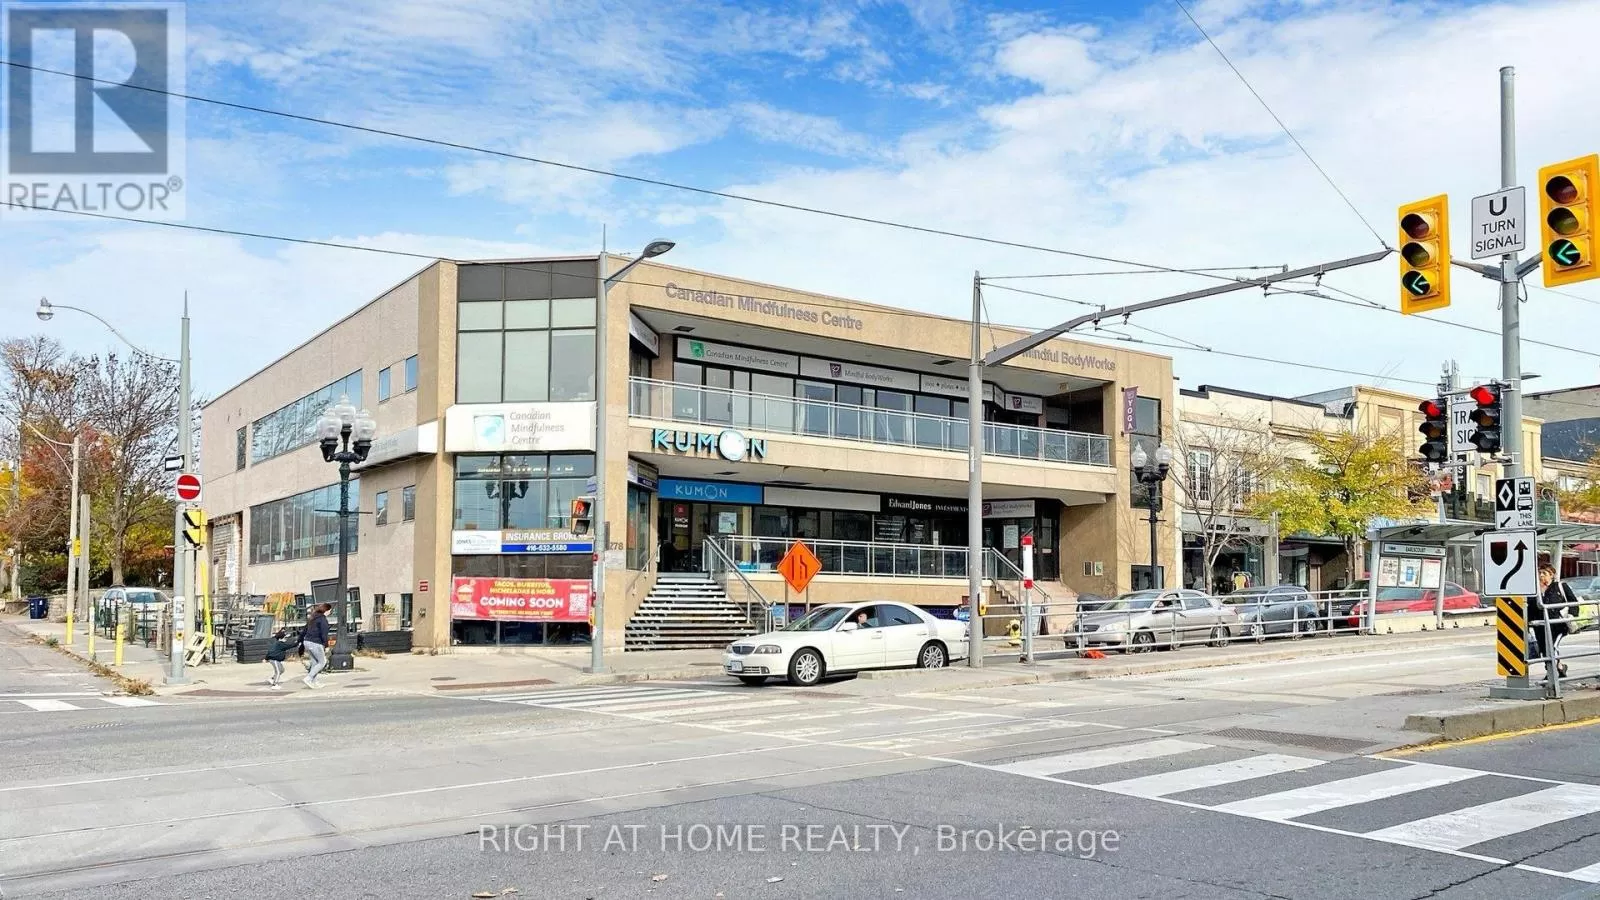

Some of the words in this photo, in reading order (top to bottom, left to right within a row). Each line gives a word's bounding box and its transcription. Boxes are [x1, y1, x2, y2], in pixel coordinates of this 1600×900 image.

[1489, 196, 1507, 216] U
[1481, 218, 1516, 235] TURN
[1475, 234, 1522, 252] SIGNAL
[665, 282, 734, 308] Canadian
[737, 296, 818, 323] Mindfulness
[821, 311, 863, 330] Centre
[706, 350, 733, 360] Canadian
[734, 354, 769, 365] Mindfulness
[769, 359, 789, 368] Centre
[1022, 347, 1059, 363] Mindful
[1061, 351, 1116, 371] BodyWorks
[510, 410, 551, 420] Canadian
[511, 422, 565, 435] Mindfulness
[511, 435, 541, 444] Centre
[652, 428, 768, 462] KUMON
[675, 484, 728, 499] KUMON
[506, 532, 550, 541] INSURANCE
[480, 596, 526, 607] COMING
[529, 597, 564, 609] SOON
